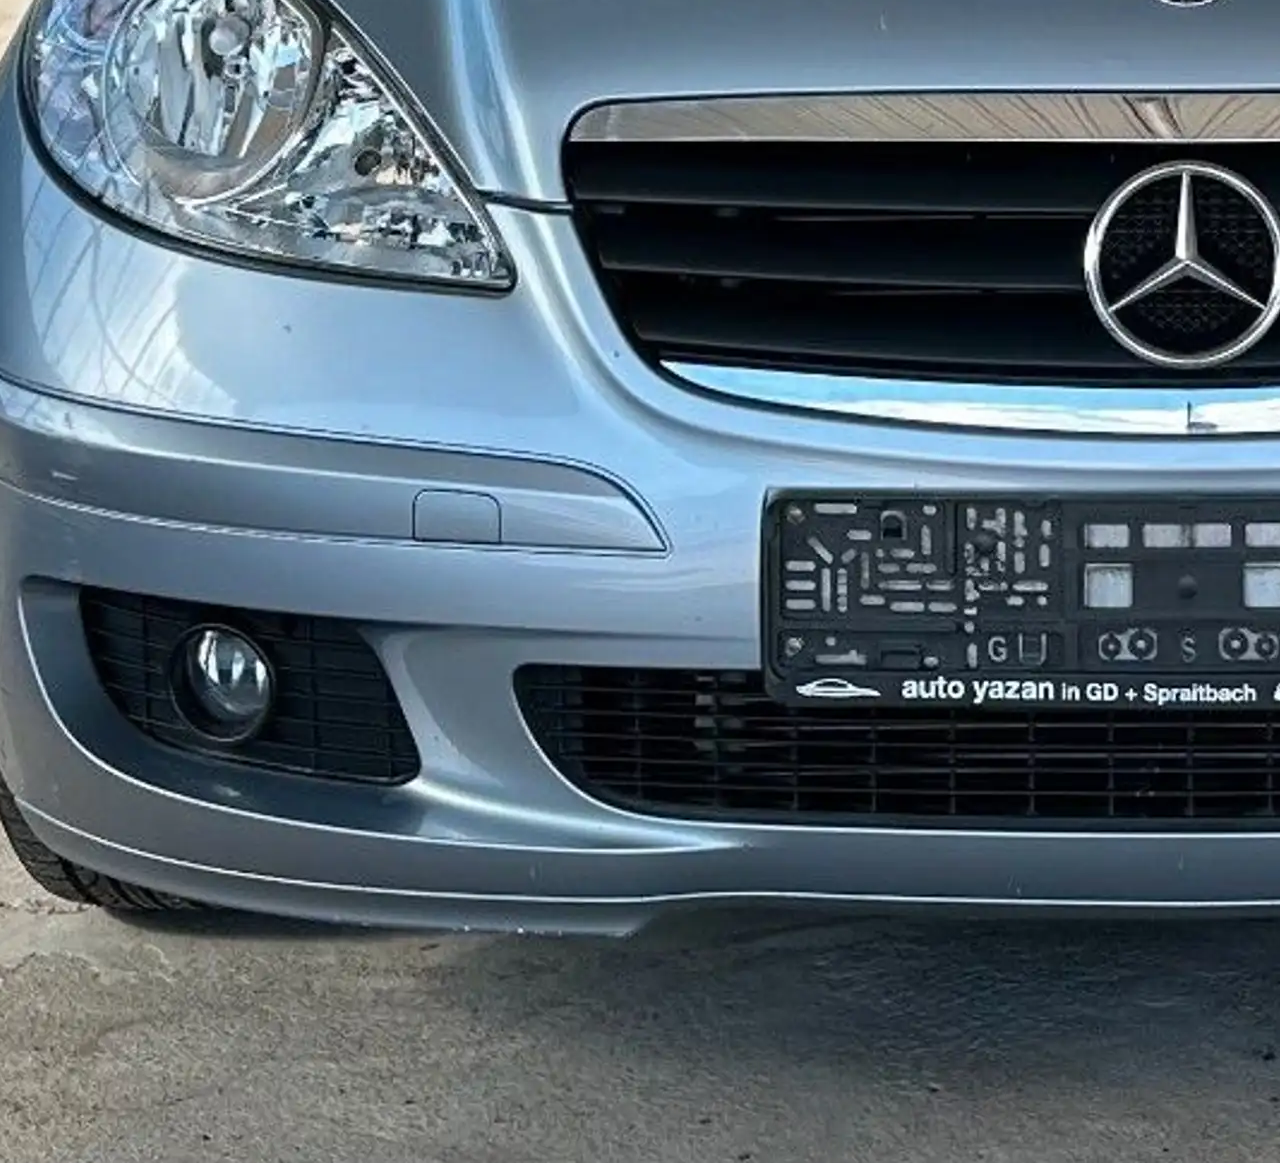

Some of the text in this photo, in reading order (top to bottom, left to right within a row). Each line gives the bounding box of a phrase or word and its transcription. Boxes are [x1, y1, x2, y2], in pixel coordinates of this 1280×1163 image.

[901, 675, 965, 700] auto
[972, 680, 1055, 704] yazan
[1061, 682, 1080, 701] in
[1086, 682, 1119, 702] GD
[1124, 688, 1138, 701] +
[1143, 682, 1257, 705] Spraitbach
